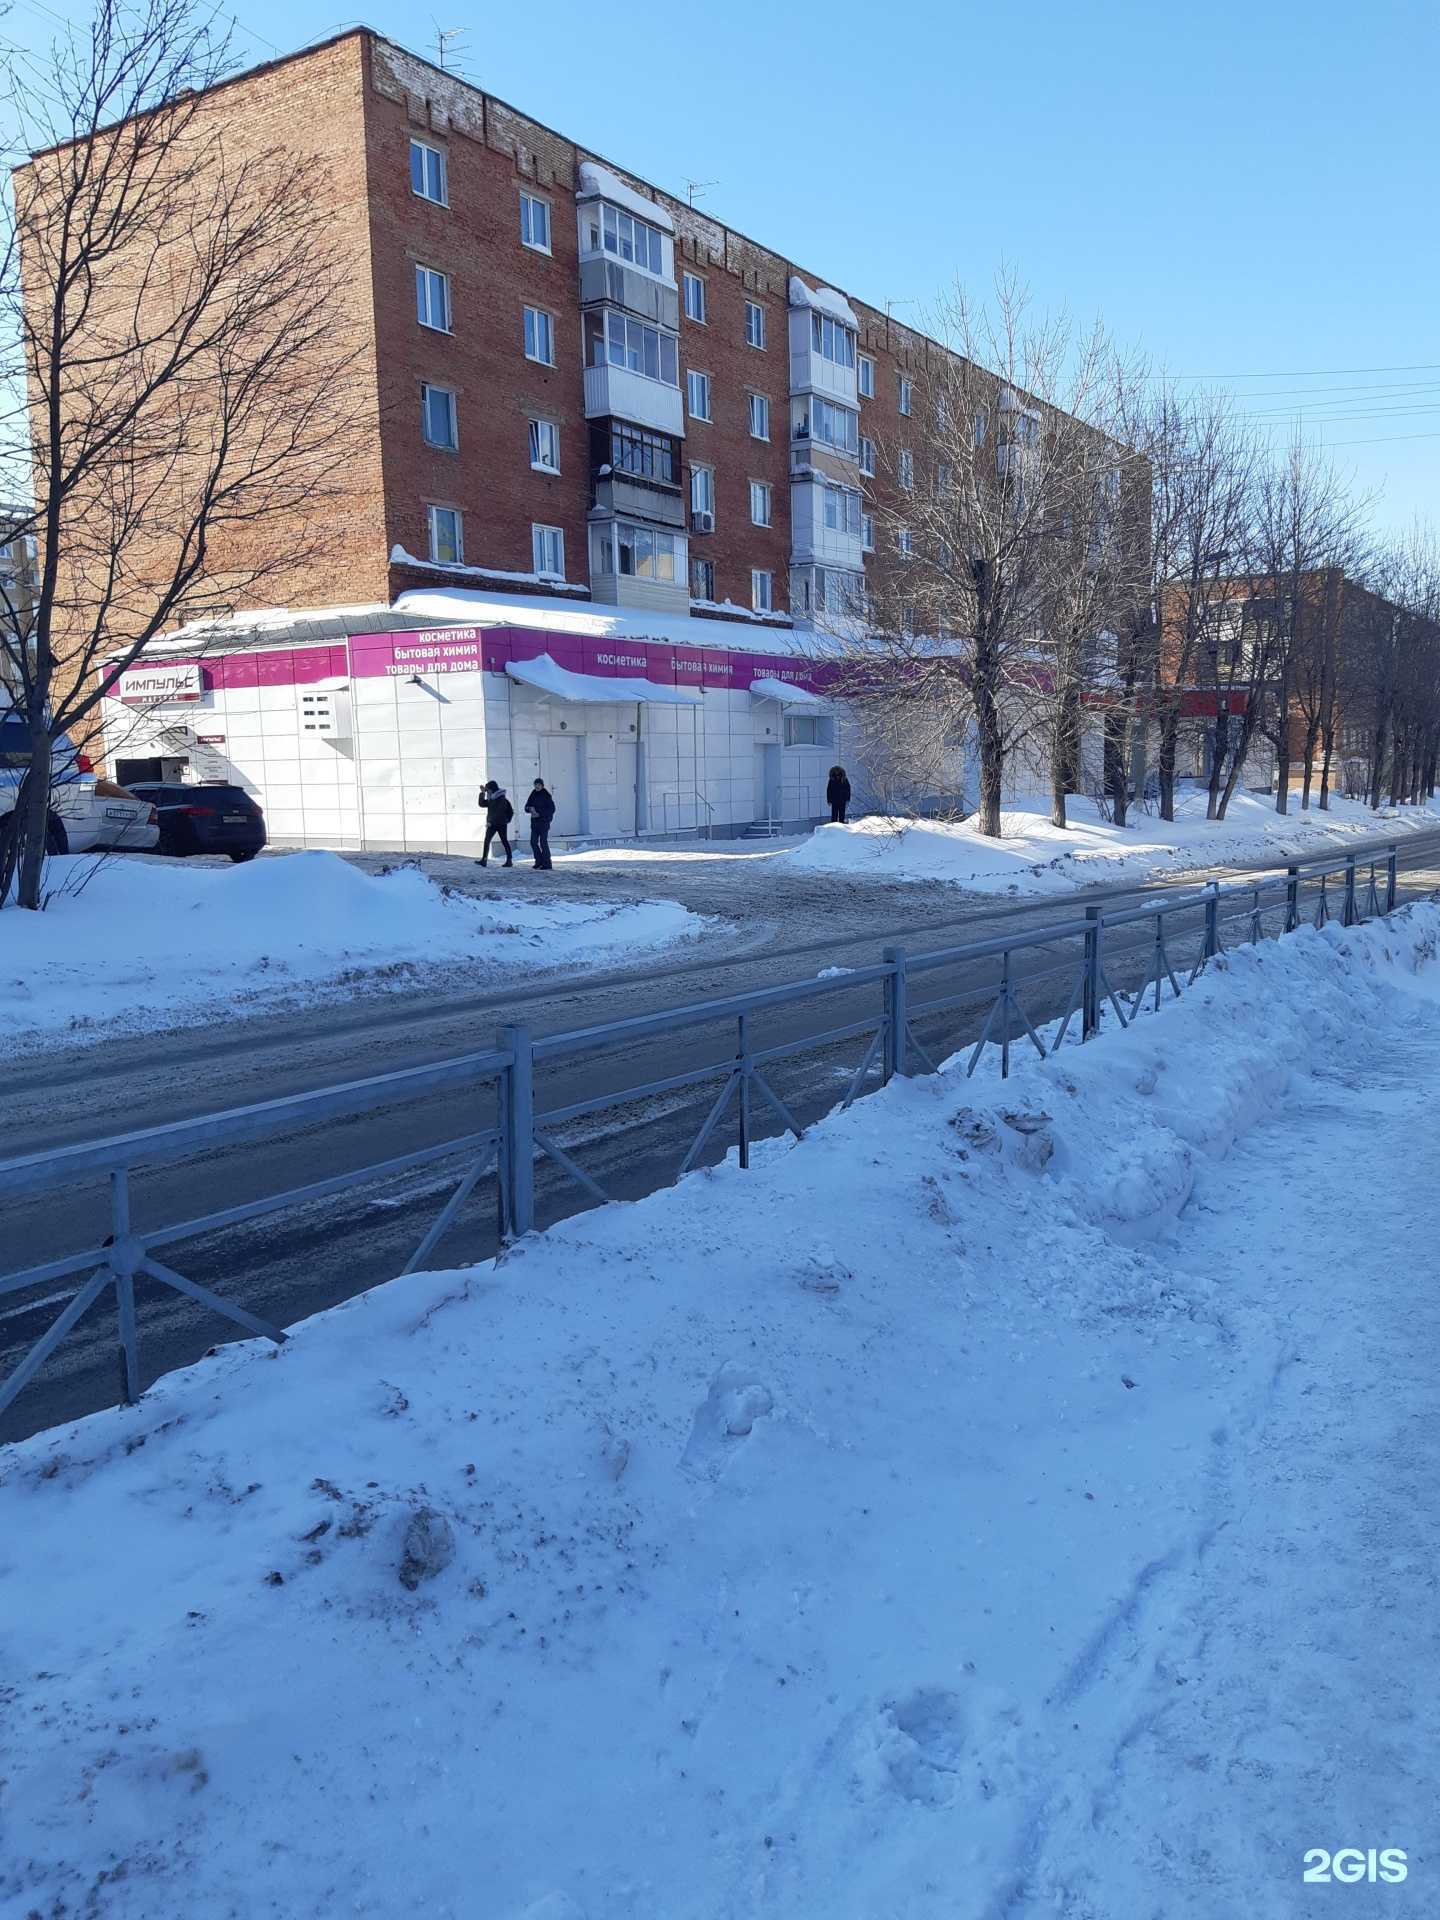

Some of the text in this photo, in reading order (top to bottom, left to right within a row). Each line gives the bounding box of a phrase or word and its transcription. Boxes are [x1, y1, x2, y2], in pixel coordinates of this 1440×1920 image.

[419, 629, 476, 642] косметика
[394, 644, 478, 660] бытовая химия
[385, 660, 479, 675] товары для дома
[597, 653, 647, 668] косметика
[671, 657, 733, 675] бытовая химия
[753, 667, 780, 679] товары
[125, 676, 194, 692] ИМПУЛЬС
